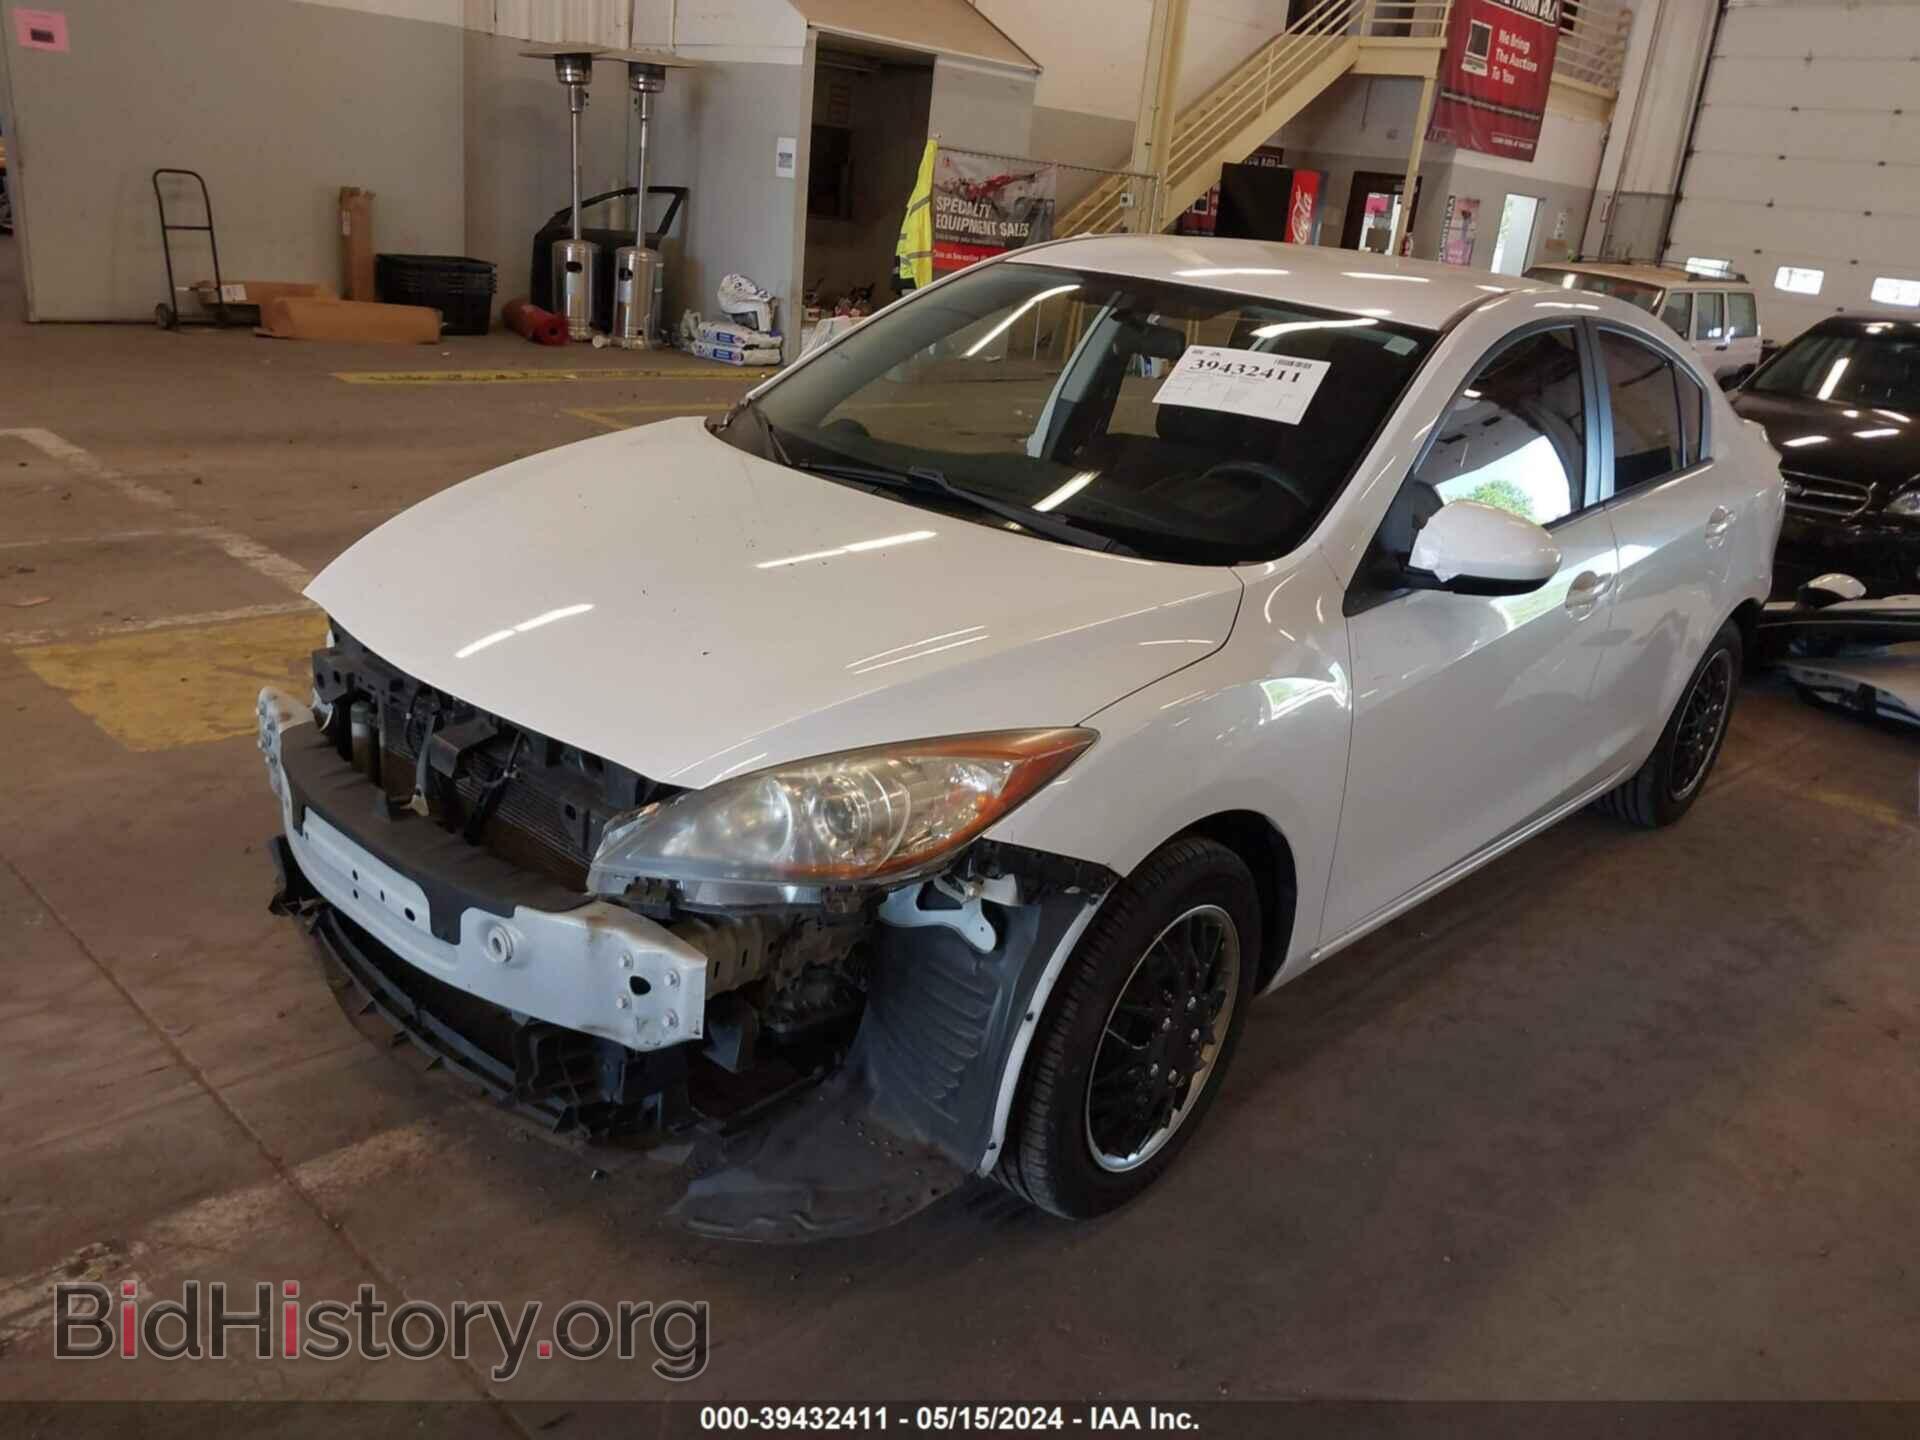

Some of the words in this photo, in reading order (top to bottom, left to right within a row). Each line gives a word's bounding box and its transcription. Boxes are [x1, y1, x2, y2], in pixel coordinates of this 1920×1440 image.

[1510, 33, 1531, 55] Bring
[1496, 48, 1509, 65] The
[1509, 53, 1538, 73] Auction
[1492, 66, 1501, 81] To
[1502, 68, 1516, 85] You
[935, 196, 992, 219] SPECIALTY
[935, 214, 998, 237] EQUIPMENT
[999, 222, 1030, 238] SALES
[1189, 359, 1302, 384] 39432411
